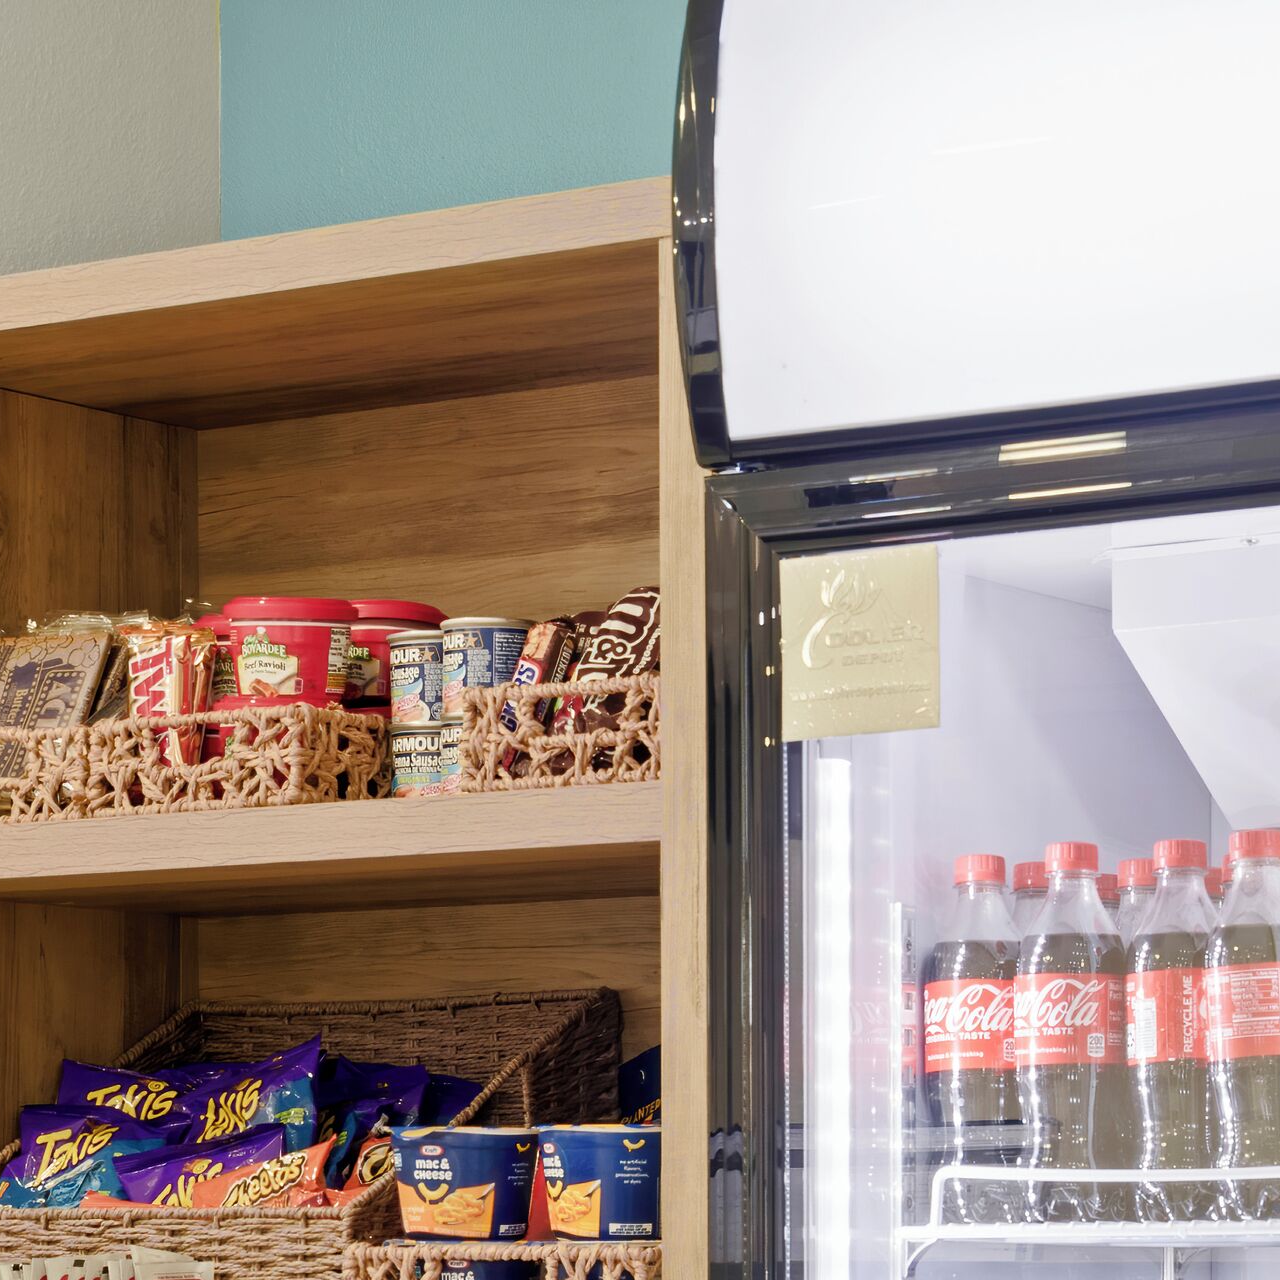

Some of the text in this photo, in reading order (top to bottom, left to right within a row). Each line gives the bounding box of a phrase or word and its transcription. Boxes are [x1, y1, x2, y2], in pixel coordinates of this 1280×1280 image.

[241, 643, 288, 658] BOYARDEE
[257, 659, 287, 671] Ravioli
[1182, 975, 1193, 1053] RECYCLE ME
[959, 1031, 991, 1042] TASTE
[1042, 1026, 1075, 1036] TASTE
[198, 1078, 263, 1144] Takis
[36, 1121, 121, 1188] Takis
[415, 1158, 450, 1170] mac &
